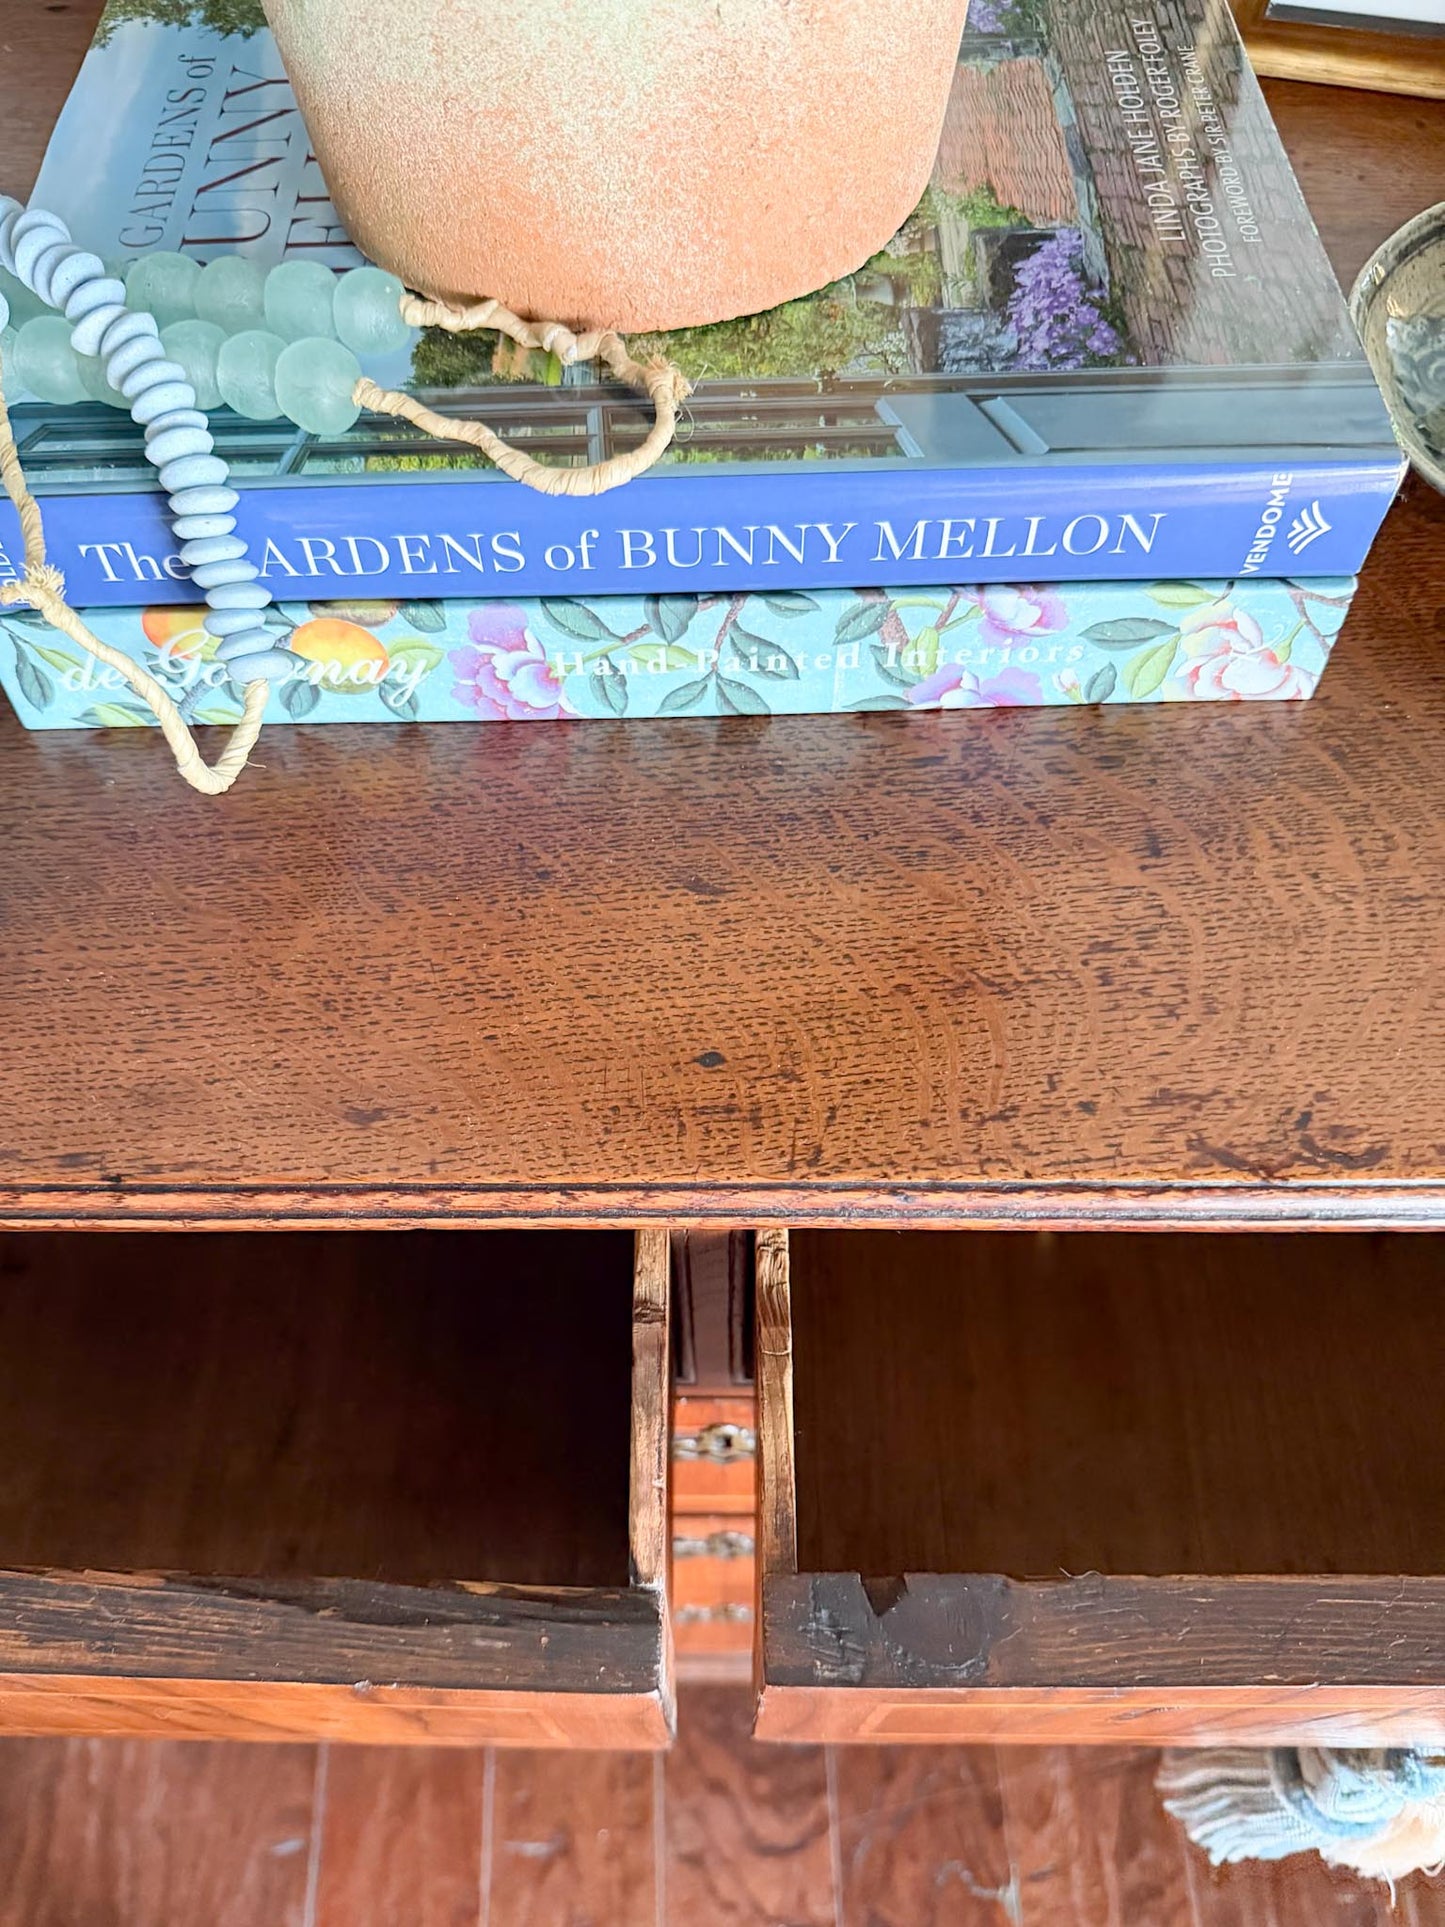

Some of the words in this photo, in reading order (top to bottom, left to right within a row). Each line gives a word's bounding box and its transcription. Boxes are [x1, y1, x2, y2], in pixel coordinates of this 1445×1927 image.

[1132, 19, 1164, 64] FOLEY
[1177, 44, 1204, 84] CRANE
[1104, 50, 1150, 124] HOLDEN
[1149, 69, 1182, 119] ROGER
[1193, 86, 1217, 123] PETER
[118, 89, 208, 248] GARDENS
[178, 53, 217, 79] of
[179, 64, 298, 257] UNNY
[1128, 131, 1166, 175] JANE
[1164, 124, 1191, 144] BY
[1204, 123, 1226, 148] SIR
[1212, 148, 1233, 166] BY
[1144, 179, 1186, 242] LINDA
[1170, 147, 1237, 278] PHOTOGRAPHS
[1218, 167, 1262, 243] FOREWORD
[79, 541, 194, 582] The
[259, 531, 526, 578] ARDENS
[544, 529, 600, 571] of
[616, 522, 858, 568] BUNNY
[870, 512, 1167, 561] MELLON
[1239, 472, 1294, 575] VENDOME
[61, 651, 129, 692] de
[151, 628, 432, 706] Gornay
[885, 637, 1085, 668] Interiors
